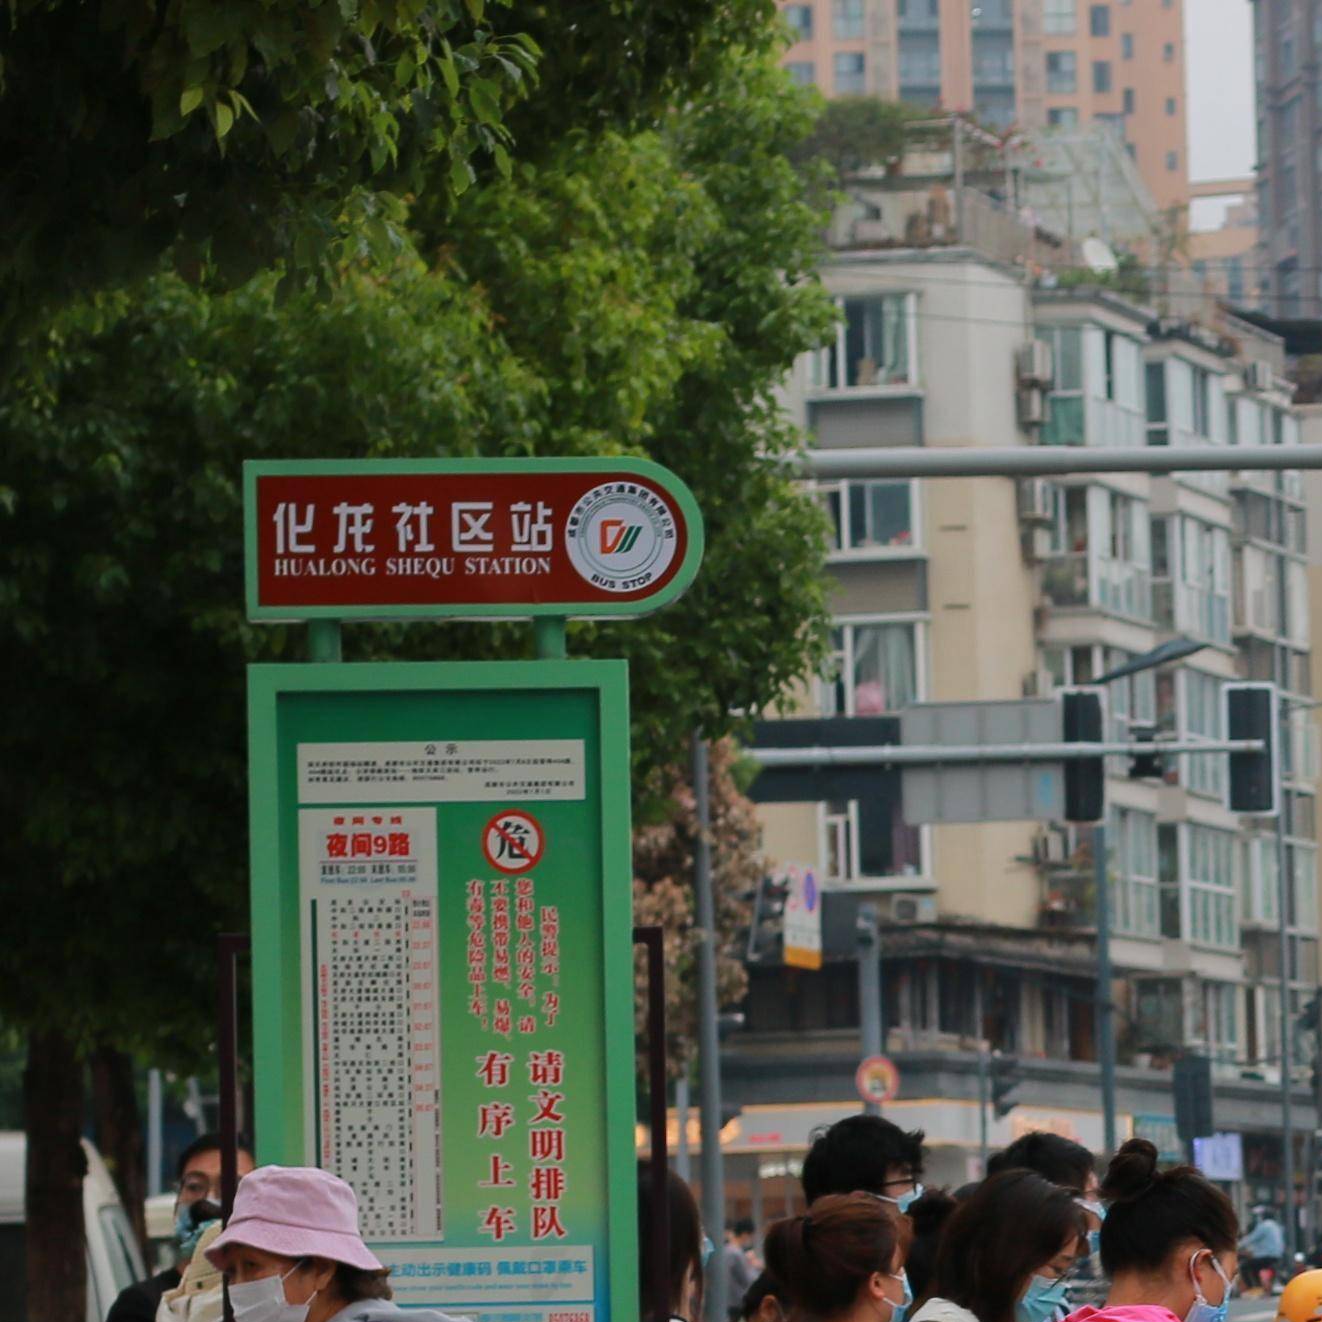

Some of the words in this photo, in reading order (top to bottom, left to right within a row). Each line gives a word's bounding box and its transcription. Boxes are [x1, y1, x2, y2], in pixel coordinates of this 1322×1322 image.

[273, 501, 553, 554] 化龙社区站
[274, 558, 376, 576] HUALONG
[386, 557, 455, 578] SHEQU
[465, 557, 551, 575] STATION
[591, 573, 616, 589] BUS
[621, 573, 653, 590] STOP
[326, 832, 410, 858] 夜间9路
[476, 1051, 516, 1241] 有序上车
[529, 1050, 566, 1239] 请文明排队
